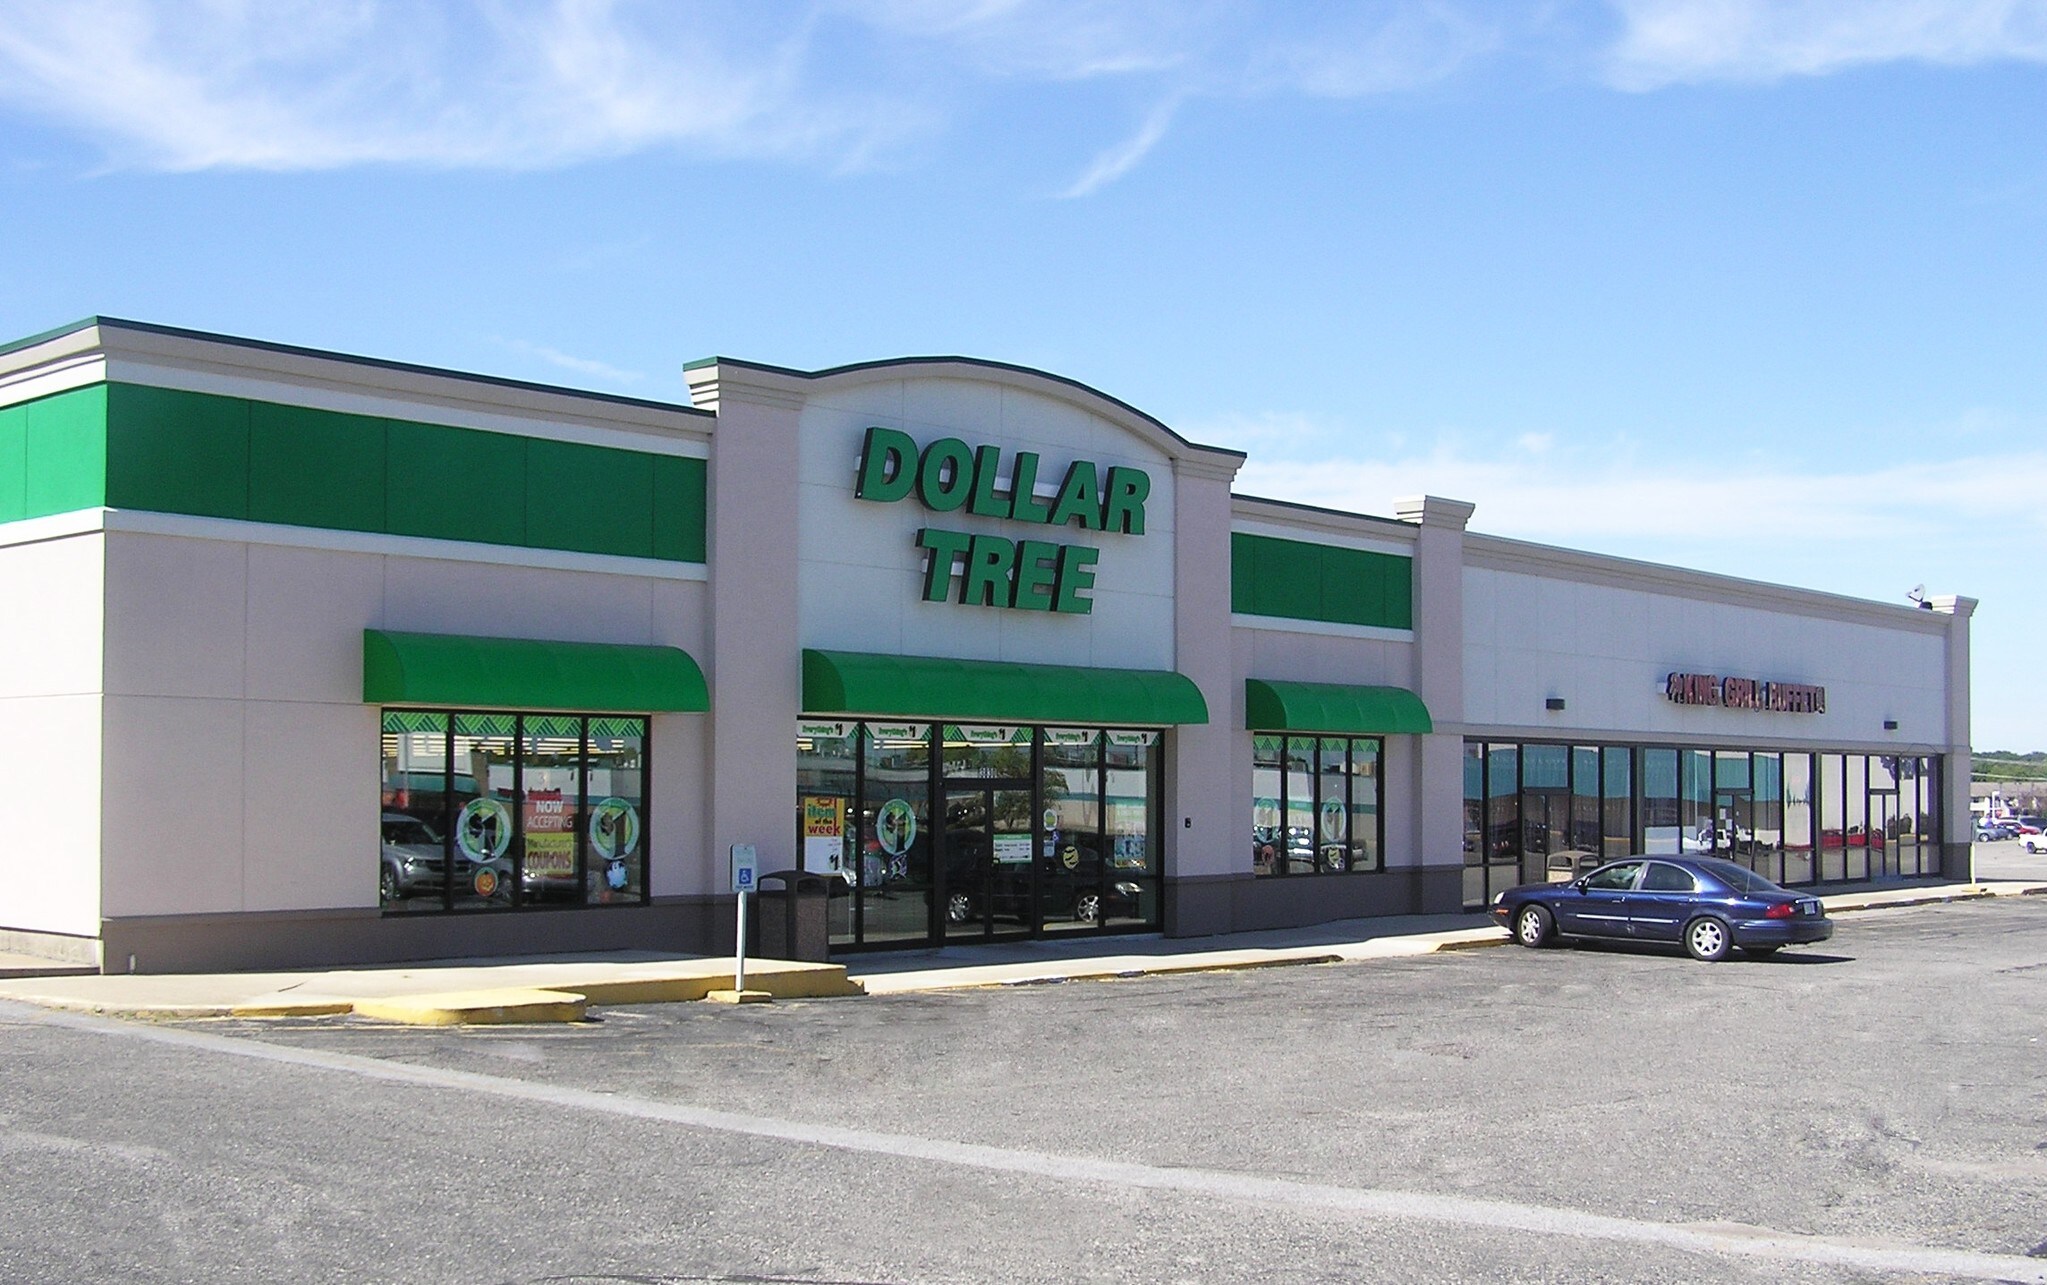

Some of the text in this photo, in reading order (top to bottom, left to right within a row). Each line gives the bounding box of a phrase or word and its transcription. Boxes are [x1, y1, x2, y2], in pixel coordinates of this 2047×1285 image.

[855, 427, 1150, 535] DOLLAR
[915, 528, 1100, 614] TREE
[536, 800, 563, 813] NOW
[808, 804, 836, 818] item
[527, 816, 573, 828] ACCEPTING
[808, 823, 841, 834] week
[528, 851, 571, 869] COUPONS
